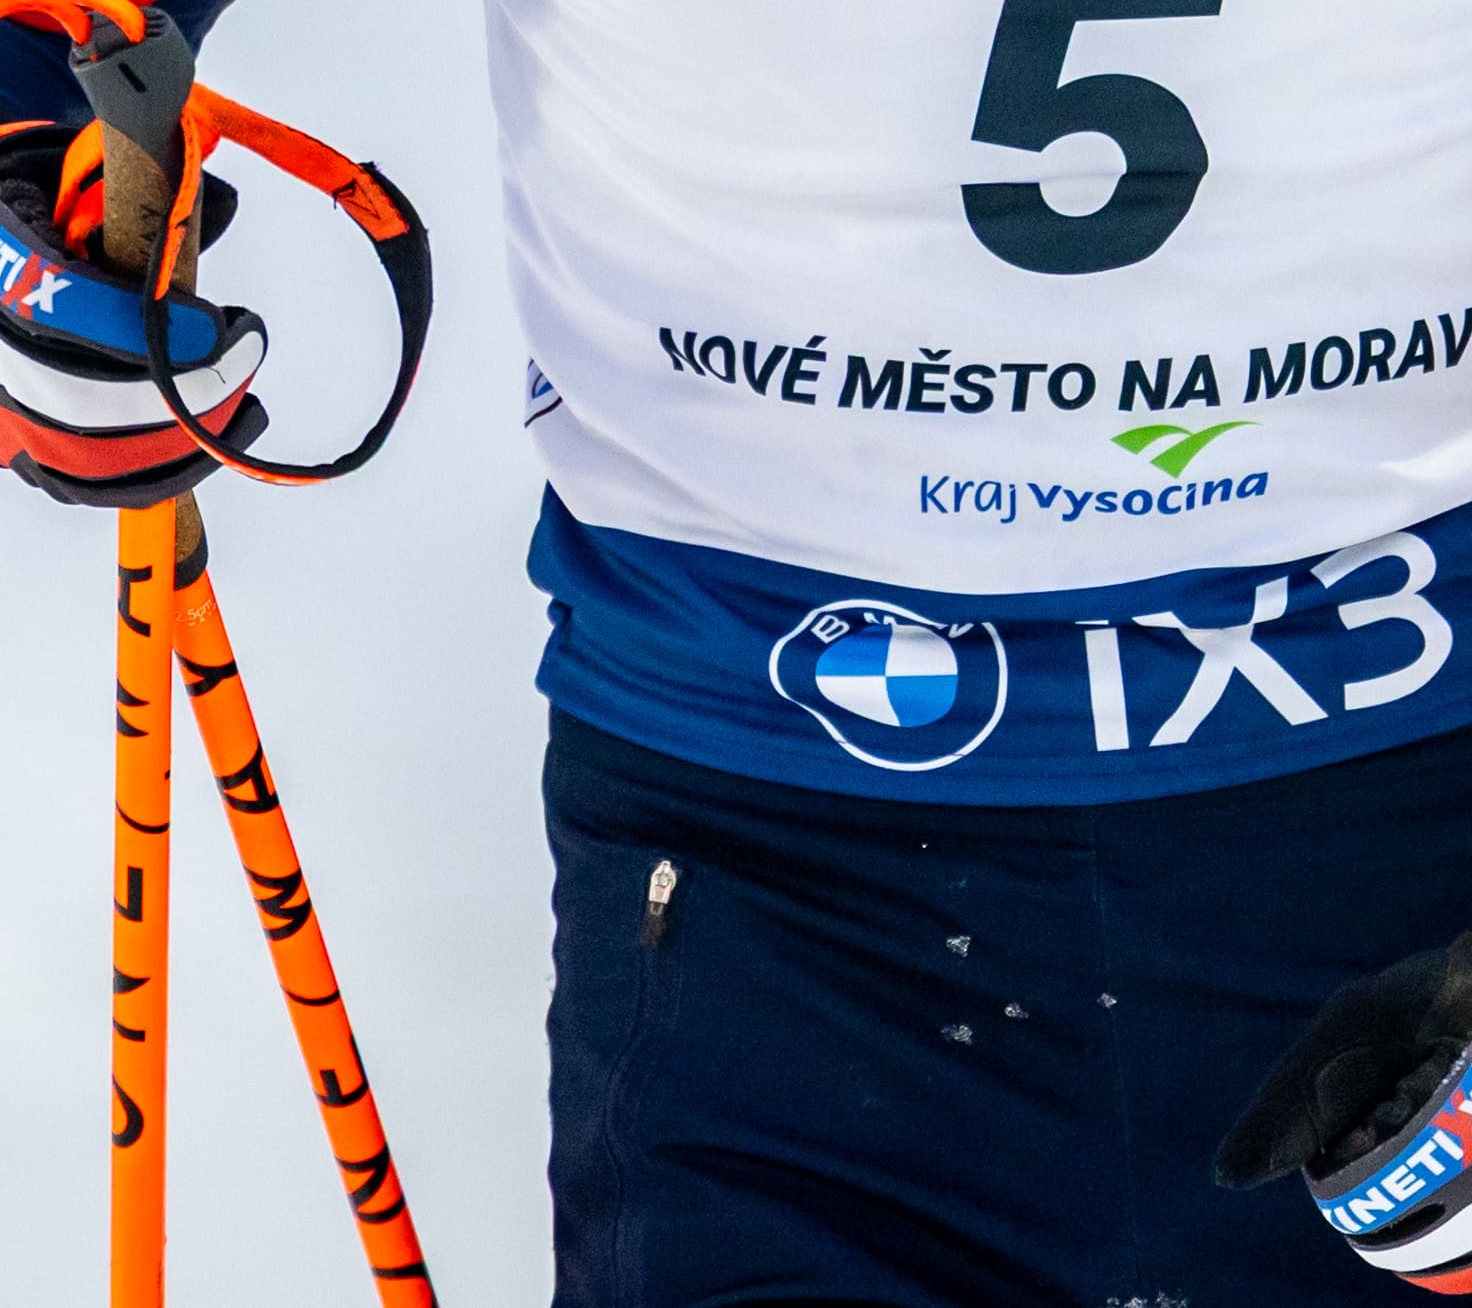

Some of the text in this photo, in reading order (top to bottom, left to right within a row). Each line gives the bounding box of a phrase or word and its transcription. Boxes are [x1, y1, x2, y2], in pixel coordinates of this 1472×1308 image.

[658, 326, 828, 405] NOVÉ
[837, 347, 1096, 414] MĚSTO
[1117, 353, 1221, 411] NA
[919, 475, 1018, 524] Kraj
